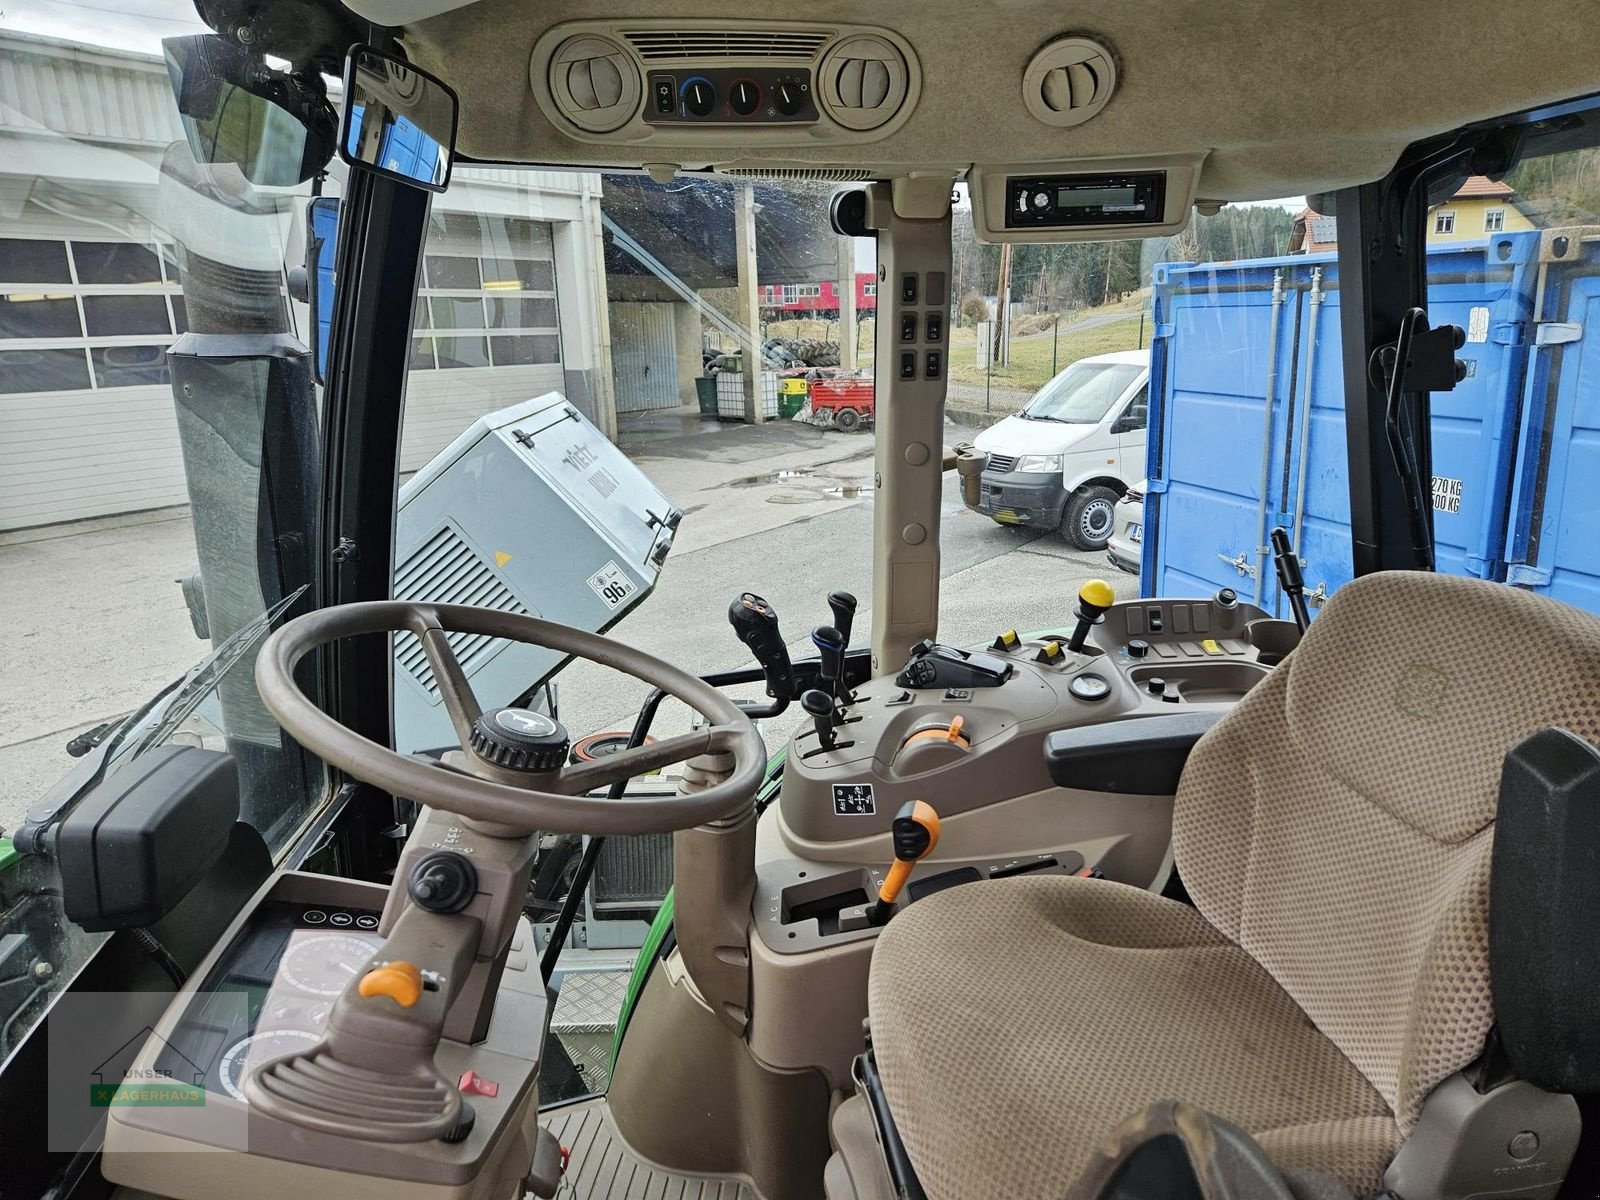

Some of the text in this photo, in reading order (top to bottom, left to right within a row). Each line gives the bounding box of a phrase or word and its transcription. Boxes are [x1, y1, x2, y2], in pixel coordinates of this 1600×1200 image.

[1450, 480, 1462, 496] KG
[1432, 494, 1447, 510] 00
[1448, 497, 1460, 513] KG
[603, 581, 627, 604] 96
